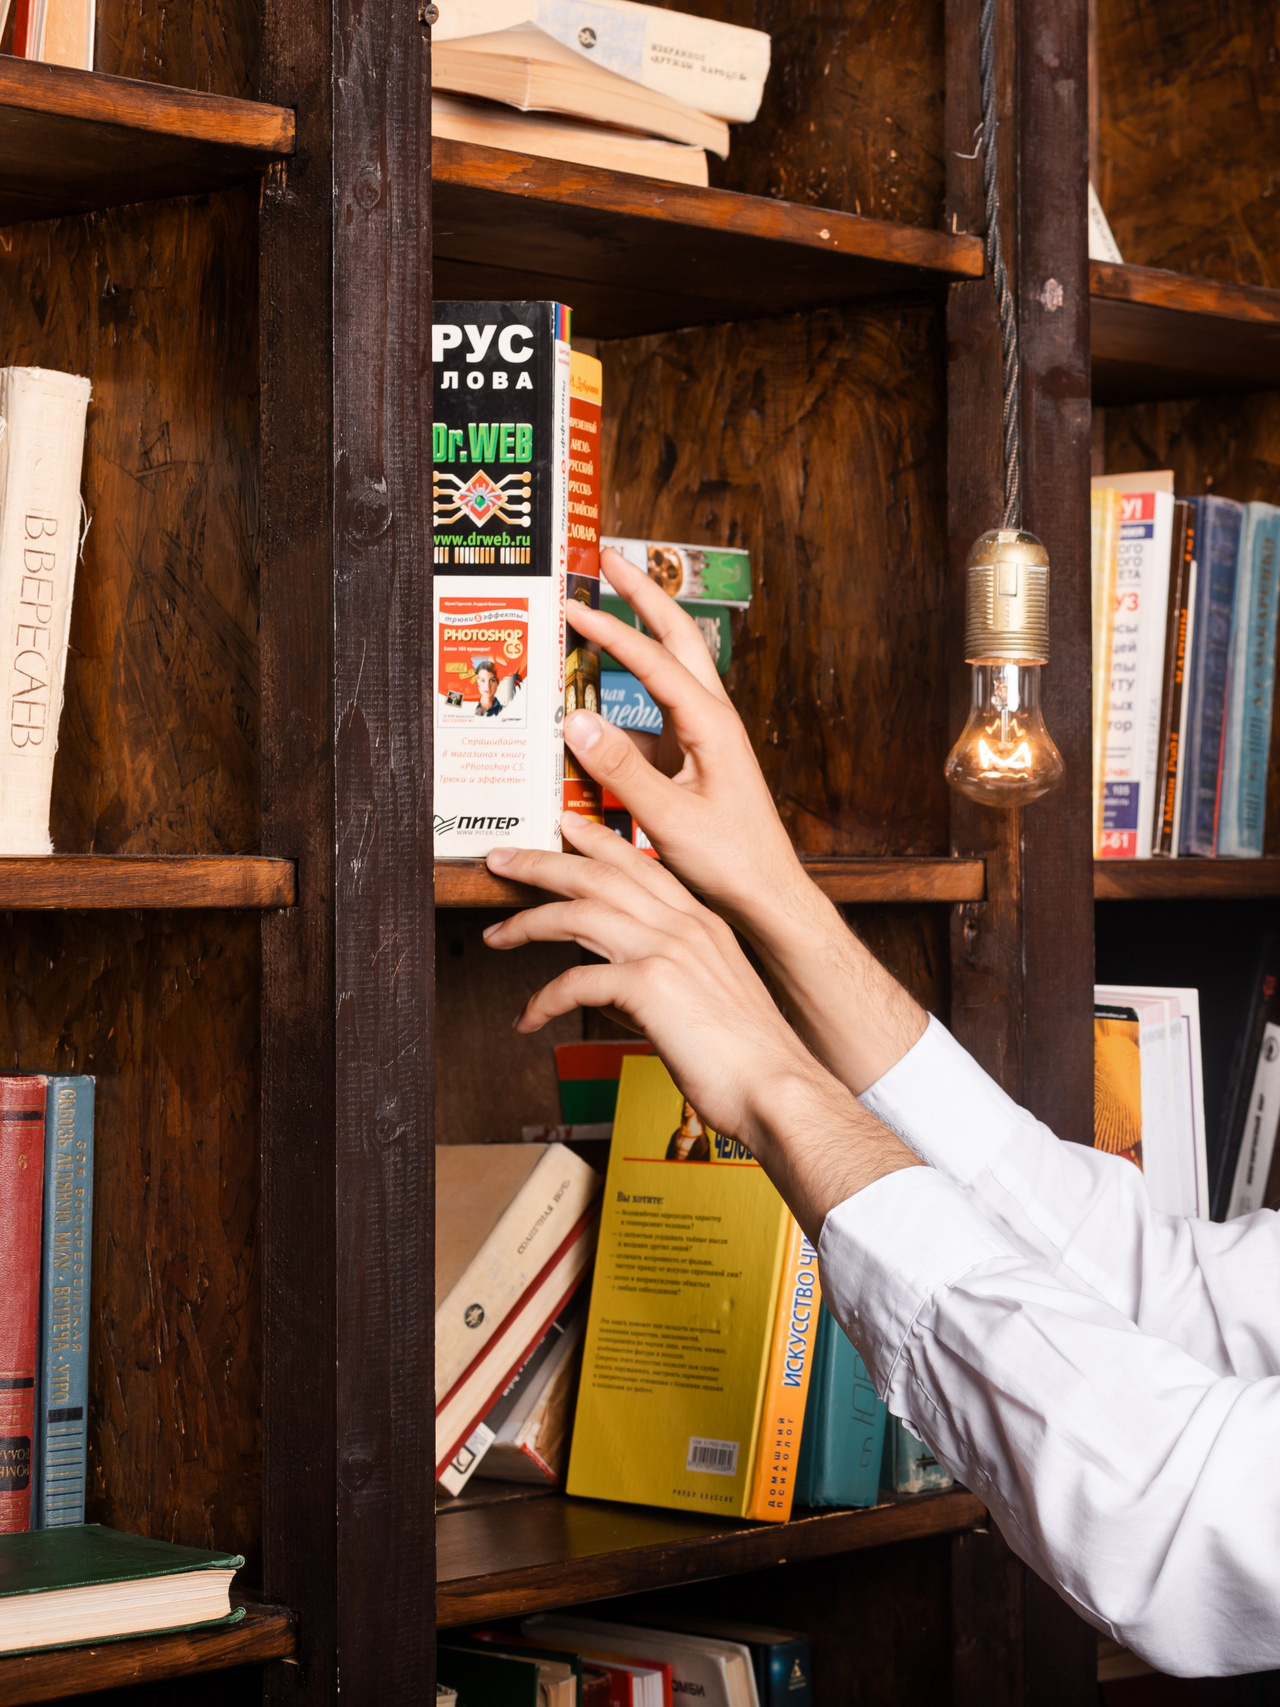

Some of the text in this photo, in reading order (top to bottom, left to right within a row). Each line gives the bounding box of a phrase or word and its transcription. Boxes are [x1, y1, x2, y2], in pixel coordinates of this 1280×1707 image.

[432, 324, 534, 363] РУС
[441, 371, 533, 390] ЛОВА
[433, 423, 533, 462] Dr.WEB
[444, 629, 523, 641] PHOTOSHOP
[445, 616, 473, 624] трюки
[483, 612, 523, 620] эффекты
[557, 572, 566, 693] CorelDRAW
[505, 643, 521, 654] CS
[601, 692, 663, 729] меди
[461, 737, 527, 746] Спрашивайте
[501, 751, 527, 759] книгу
[439, 775, 467, 784] Трюки
[477, 775, 526, 785] эффекты»
[460, 762, 510, 772] «Photoshop
[457, 816, 519, 829] ПИТЕР
[56, 1088, 76, 1147] СКВОЗЬ
[53, 1152, 74, 1224] ЛЕДЯНУЮ
[616, 1192, 664, 1205] Вы хотите:
[516, 1179, 571, 1255] СОЛНЕЧНАЯ НОЧЬ
[71, 1140, 87, 1354] ЗОЯ ВОСКРЕСЕНСКАЯ
[51, 1286, 72, 1352] ВСТРЕЧА
[783, 1232, 818, 1388] ИСКУССТВО ЧИ
[50, 1364, 70, 1404] УТРО
[0, 1448, 30, 1460] РОЛЛ
[768, 1417, 785, 1508] ДОМАШНИЙ
[776, 1418, 794, 1508] ПСИХОЛОГ
